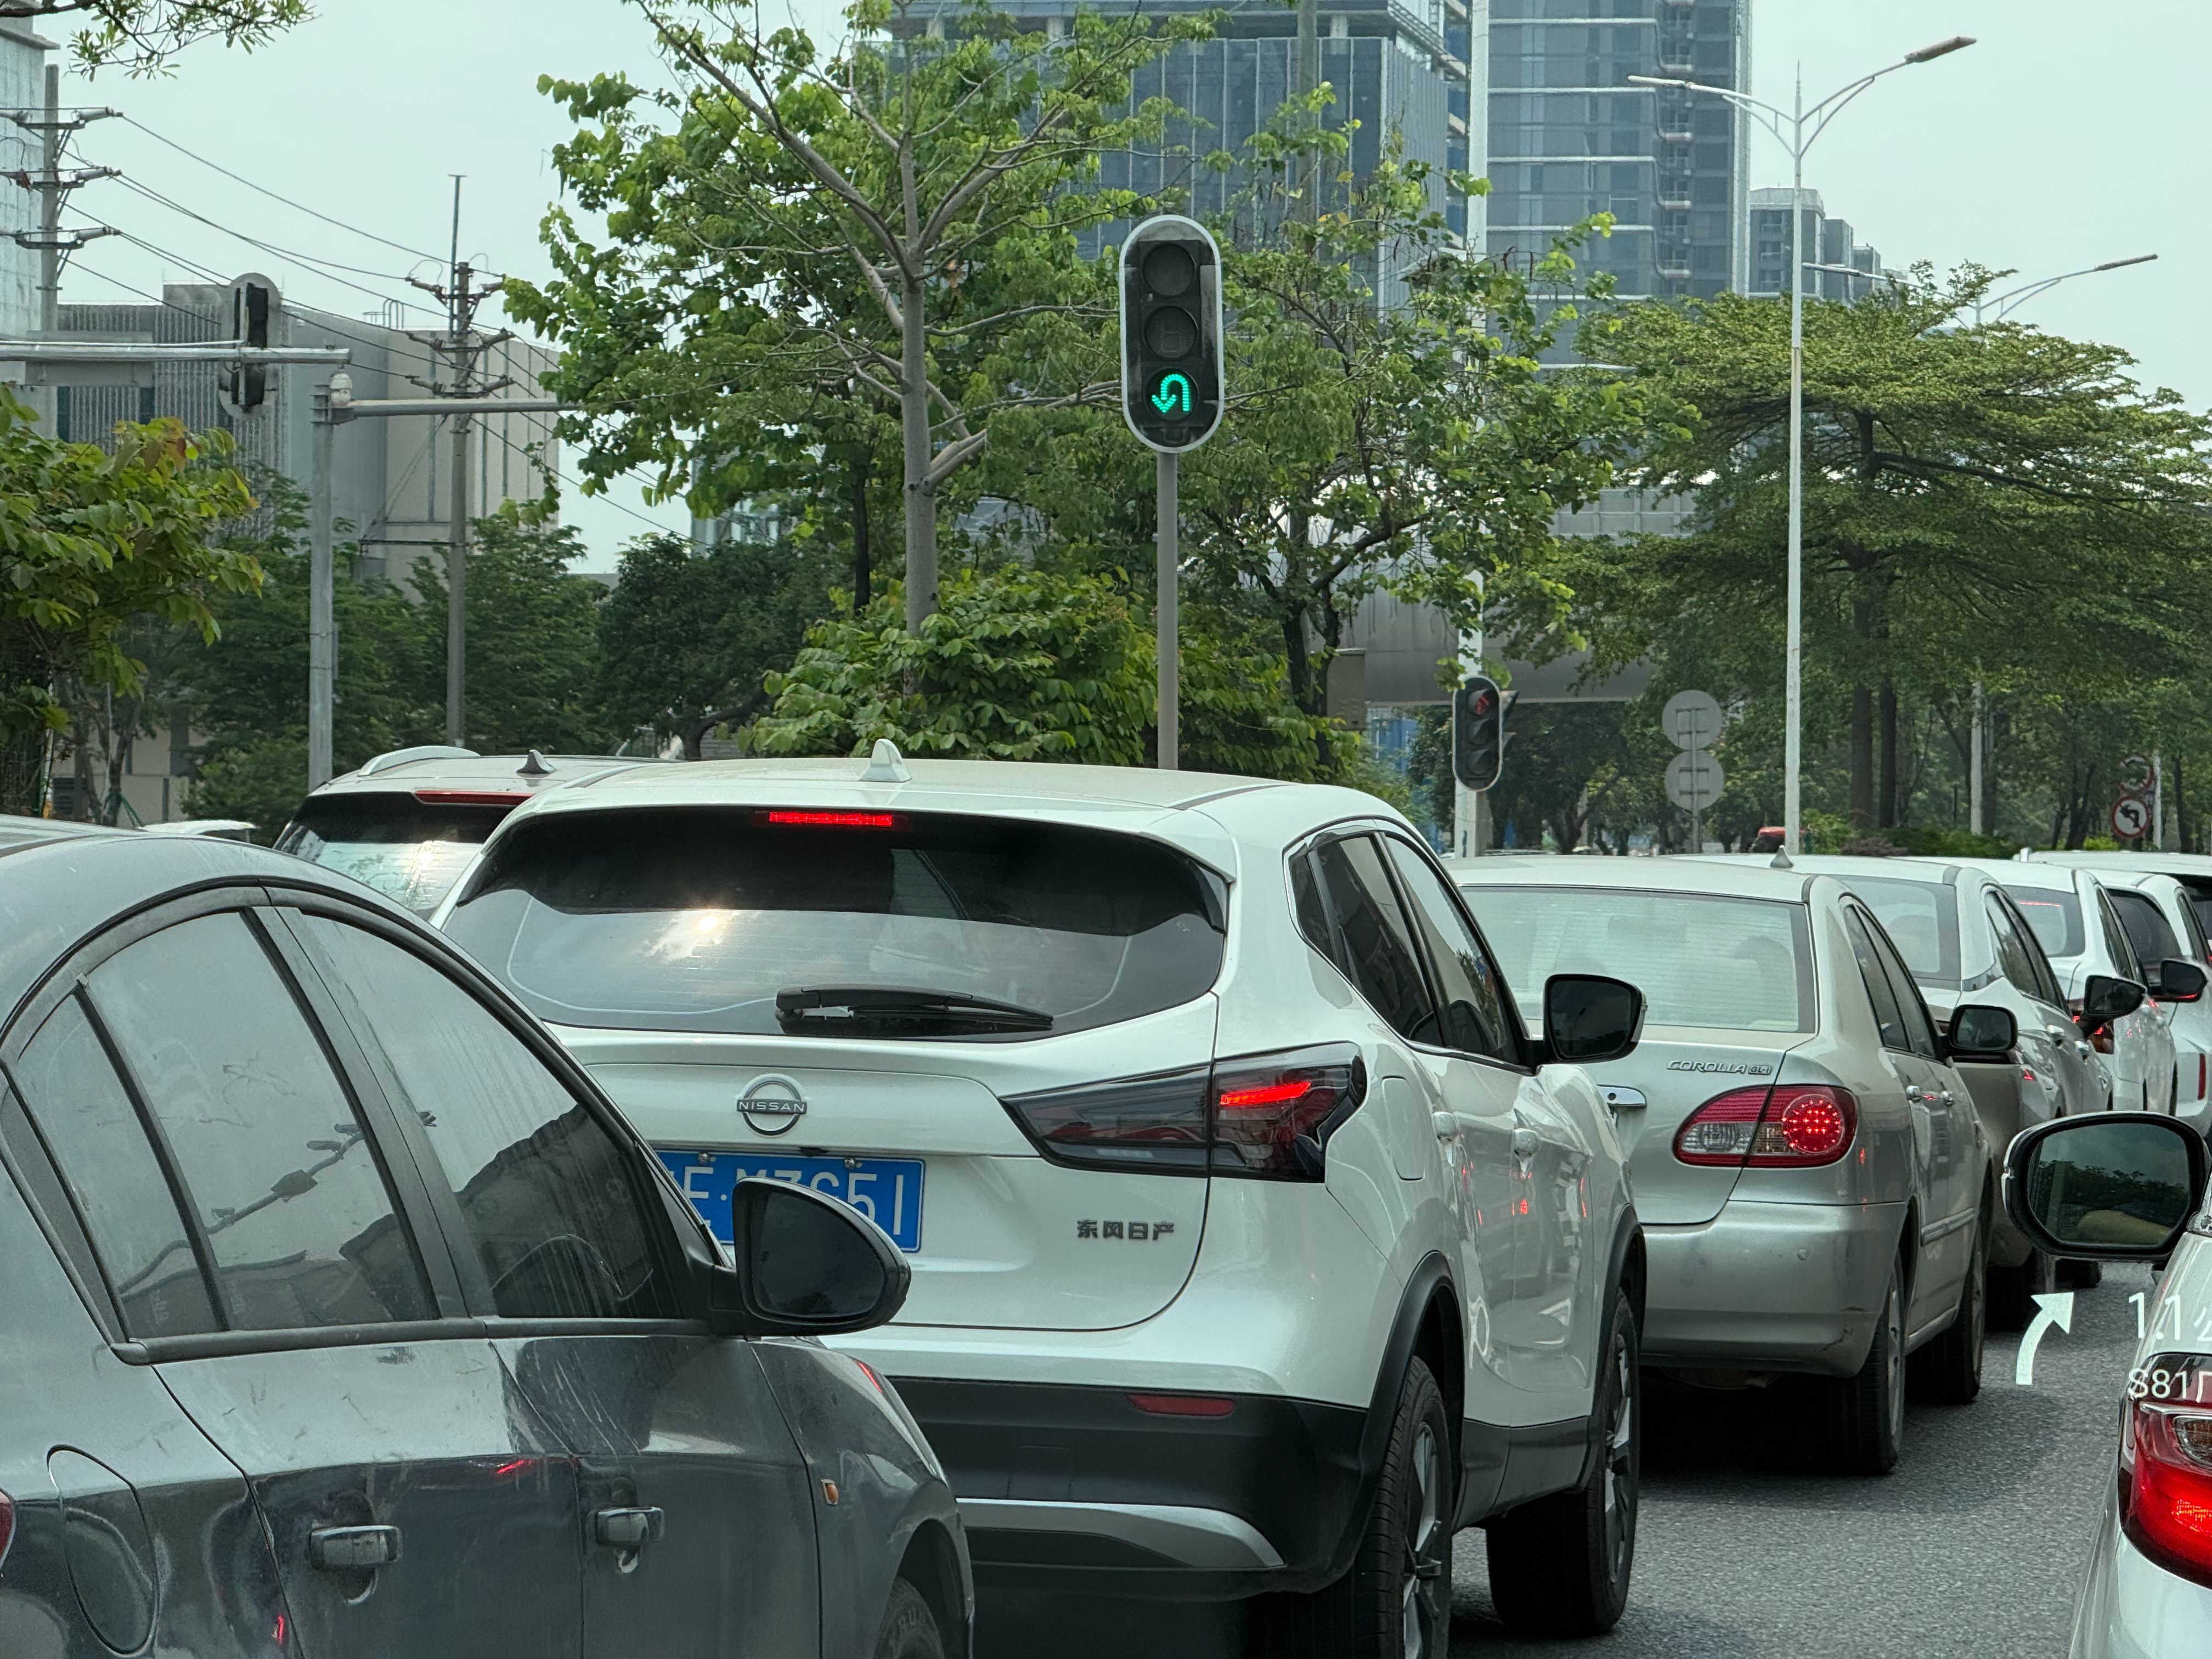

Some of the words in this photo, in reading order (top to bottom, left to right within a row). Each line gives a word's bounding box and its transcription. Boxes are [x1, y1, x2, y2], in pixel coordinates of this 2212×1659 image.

[1667, 1060, 1746, 1074] COROLLA
[739, 1101, 804, 1112] NISSAN
[1077, 1219, 1174, 1240] 东风日产
